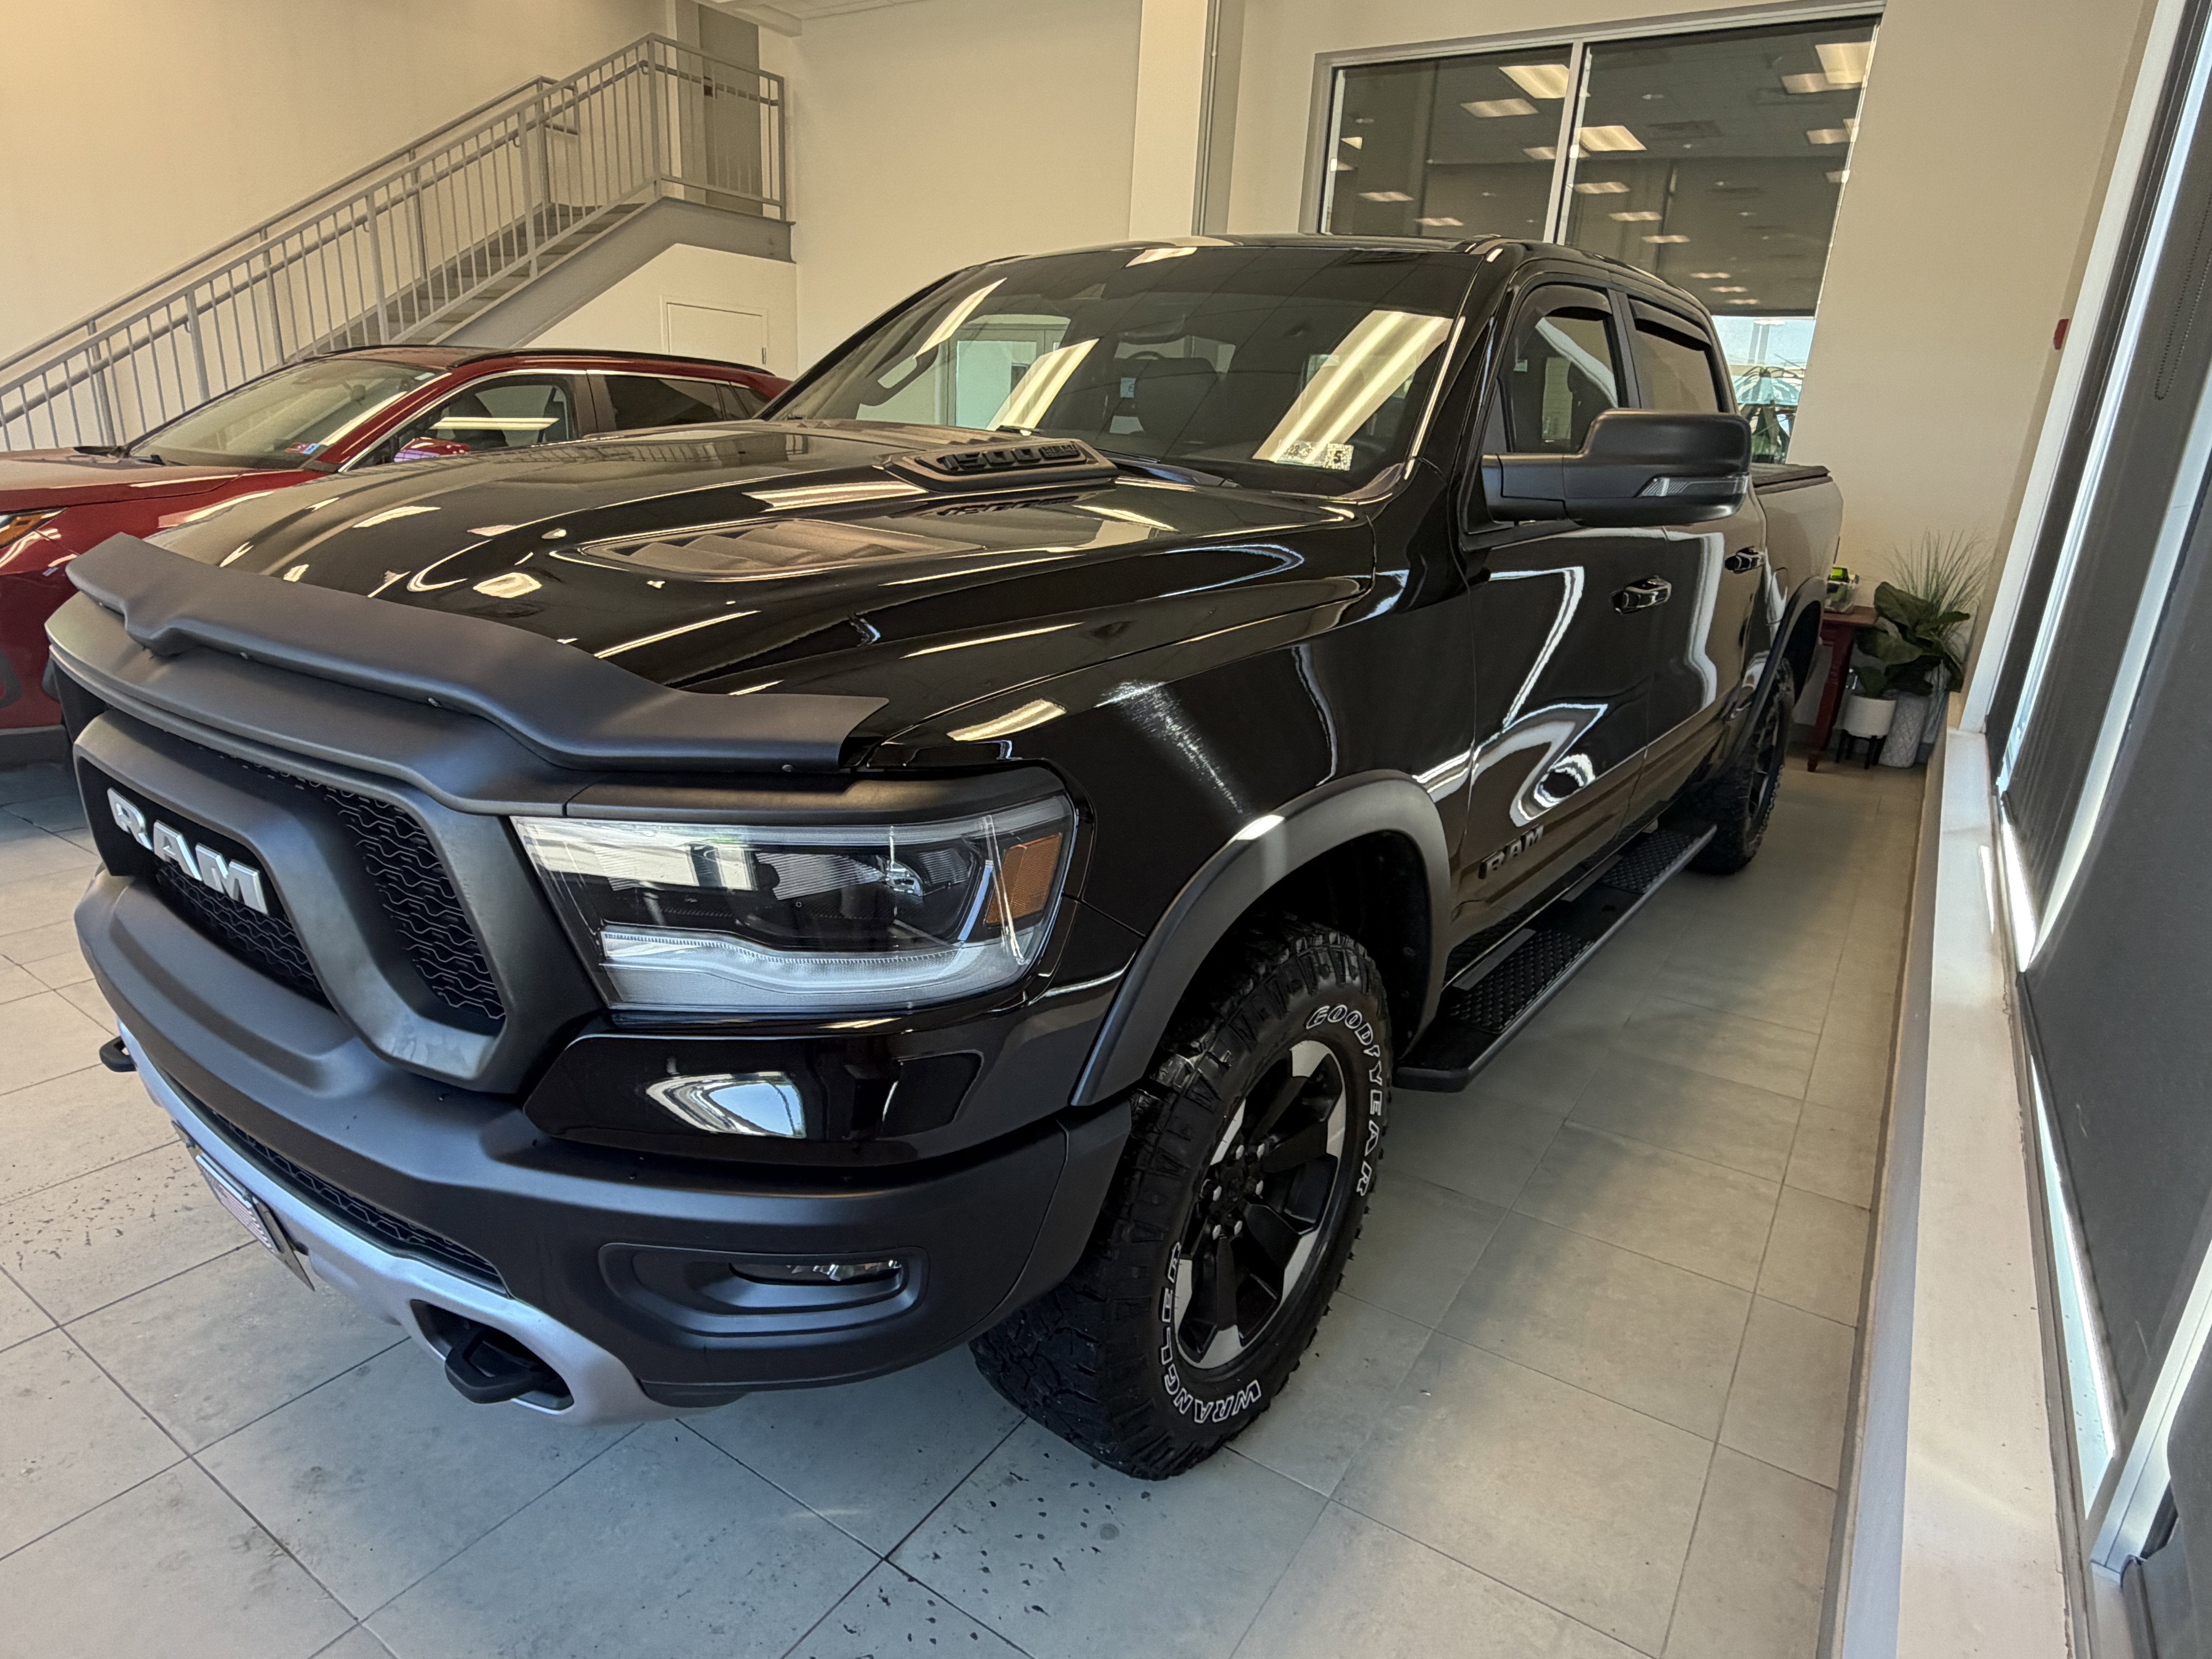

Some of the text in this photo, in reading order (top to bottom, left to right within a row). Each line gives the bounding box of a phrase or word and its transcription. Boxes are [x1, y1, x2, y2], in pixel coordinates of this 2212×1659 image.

[936, 448, 1041, 471] 1500
[107, 787, 268, 915] RAM
[1478, 823, 1544, 879] RAM
[1306, 1005, 1383, 1196] GOODYEAR
[1159, 1242, 1261, 1424] WRANGLER
